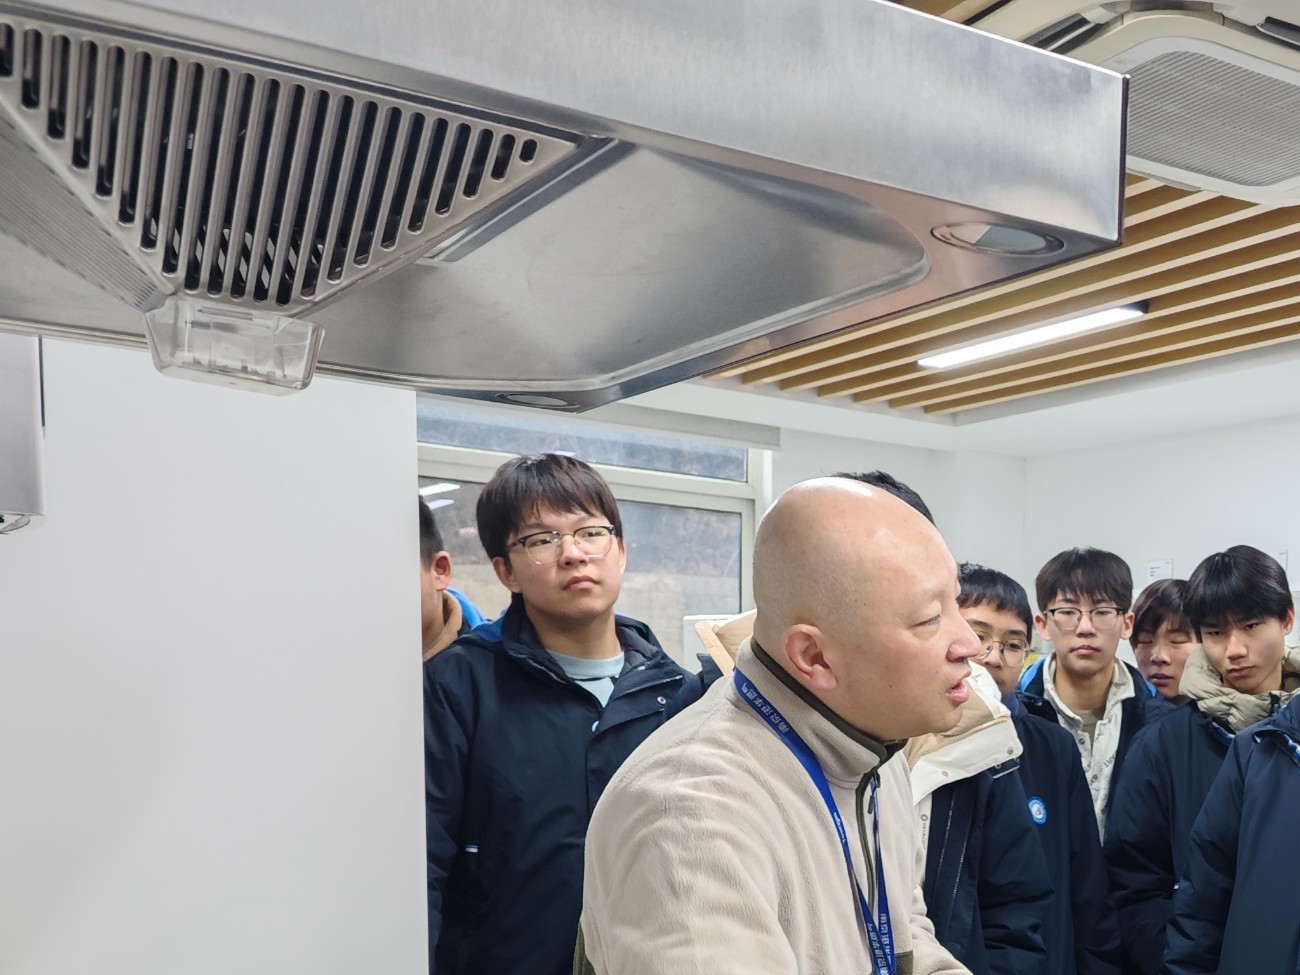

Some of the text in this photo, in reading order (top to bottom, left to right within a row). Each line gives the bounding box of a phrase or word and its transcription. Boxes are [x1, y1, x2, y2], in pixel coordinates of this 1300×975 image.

[741, 682, 790, 733] 南京港华燃气
